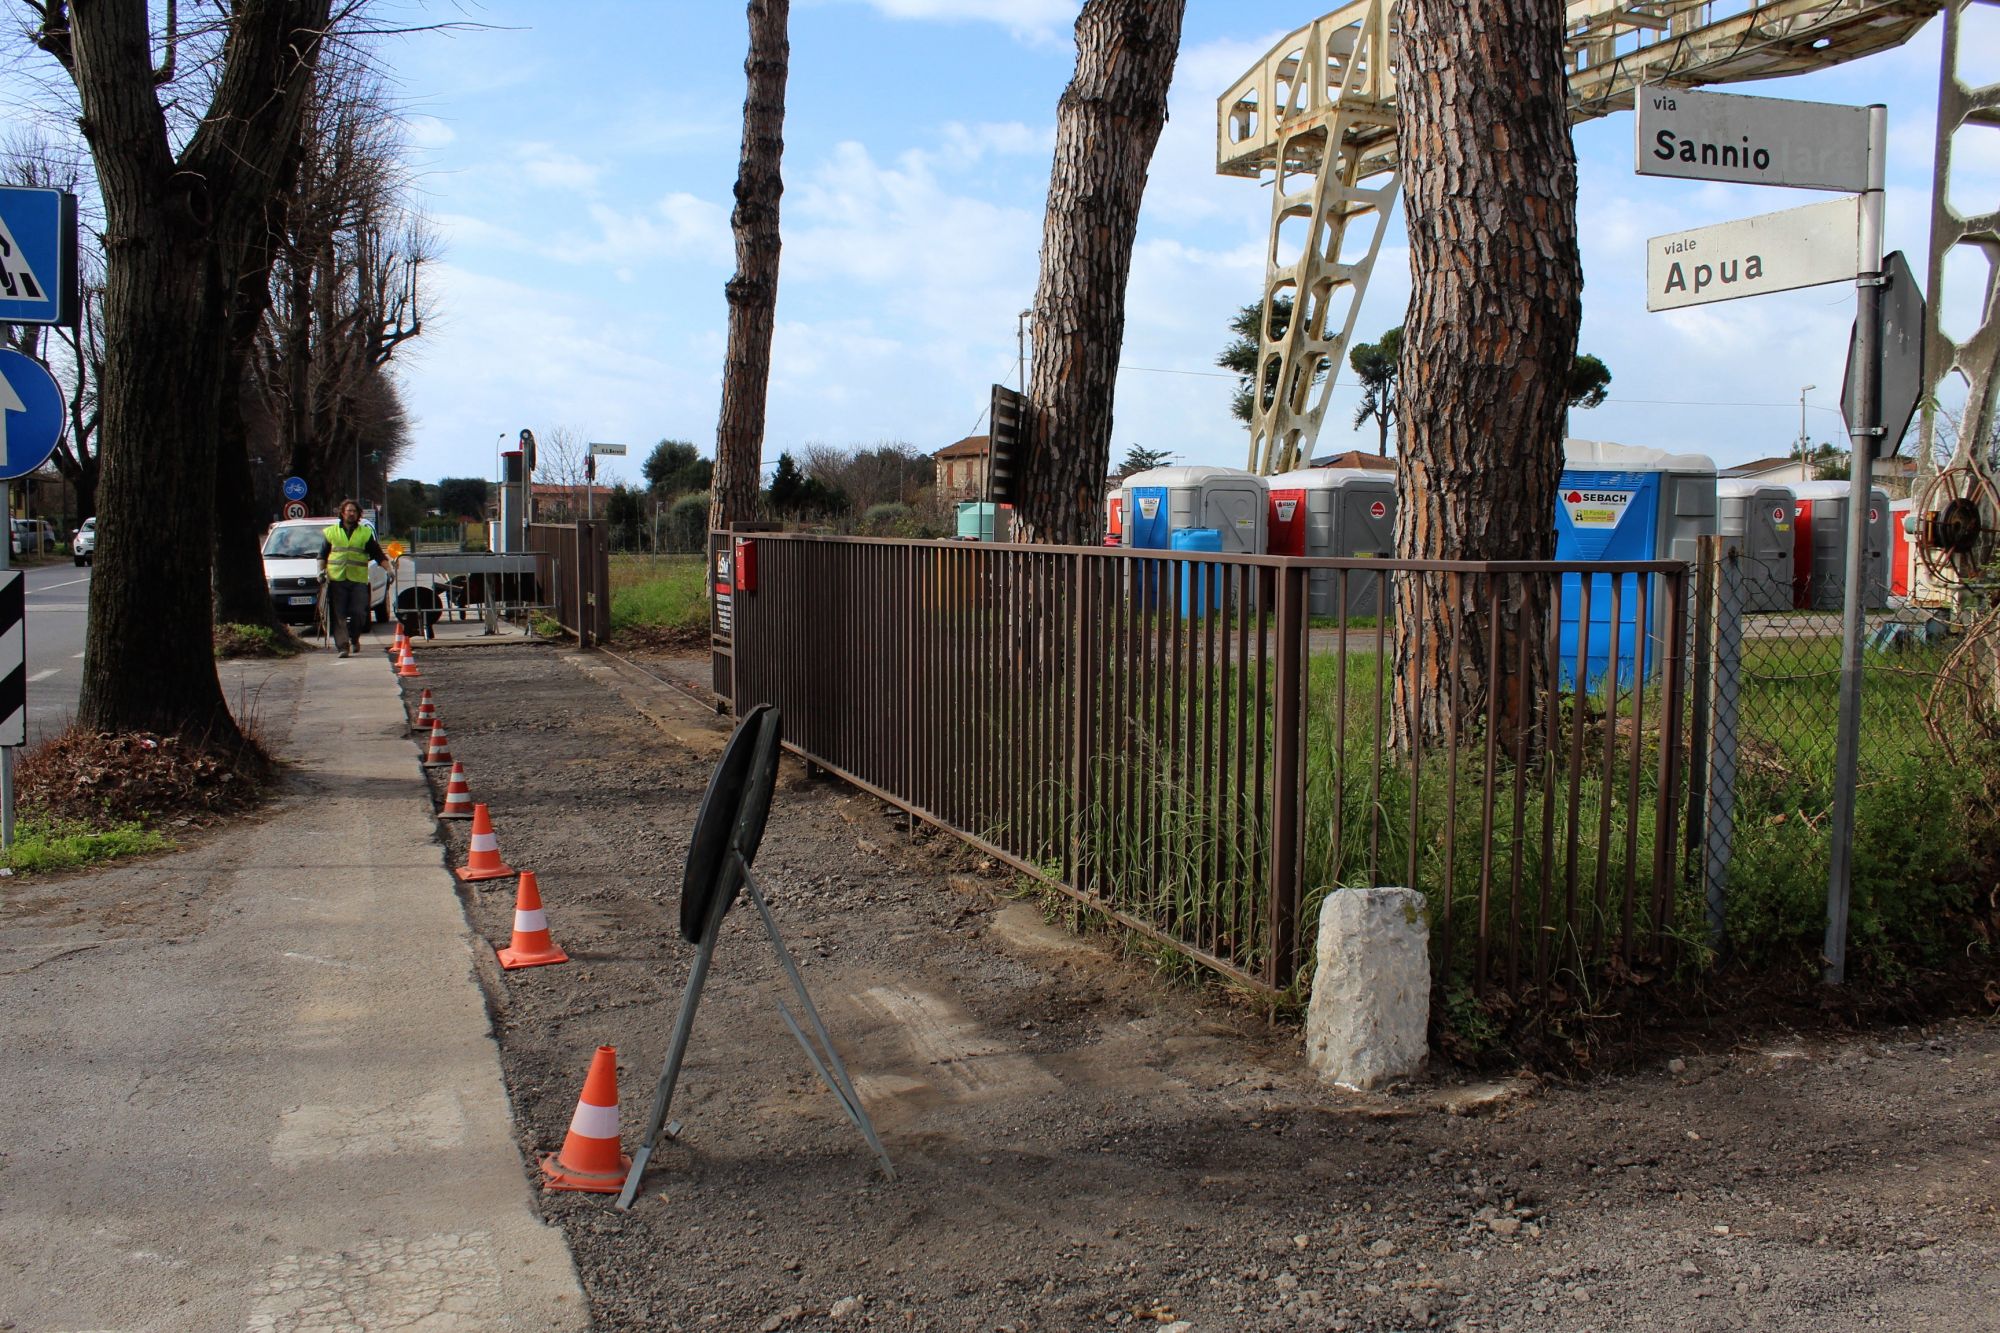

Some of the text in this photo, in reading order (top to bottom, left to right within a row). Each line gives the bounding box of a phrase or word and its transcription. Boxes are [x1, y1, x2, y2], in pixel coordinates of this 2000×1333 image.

[1653, 96, 1677, 112] via
[1653, 130, 1770, 170] Sannio
[1664, 238, 1697, 255] viale
[1663, 254, 1763, 294] Apua
[1583, 494, 1627, 502] SEBACH
[290, 507, 303, 518] 50
